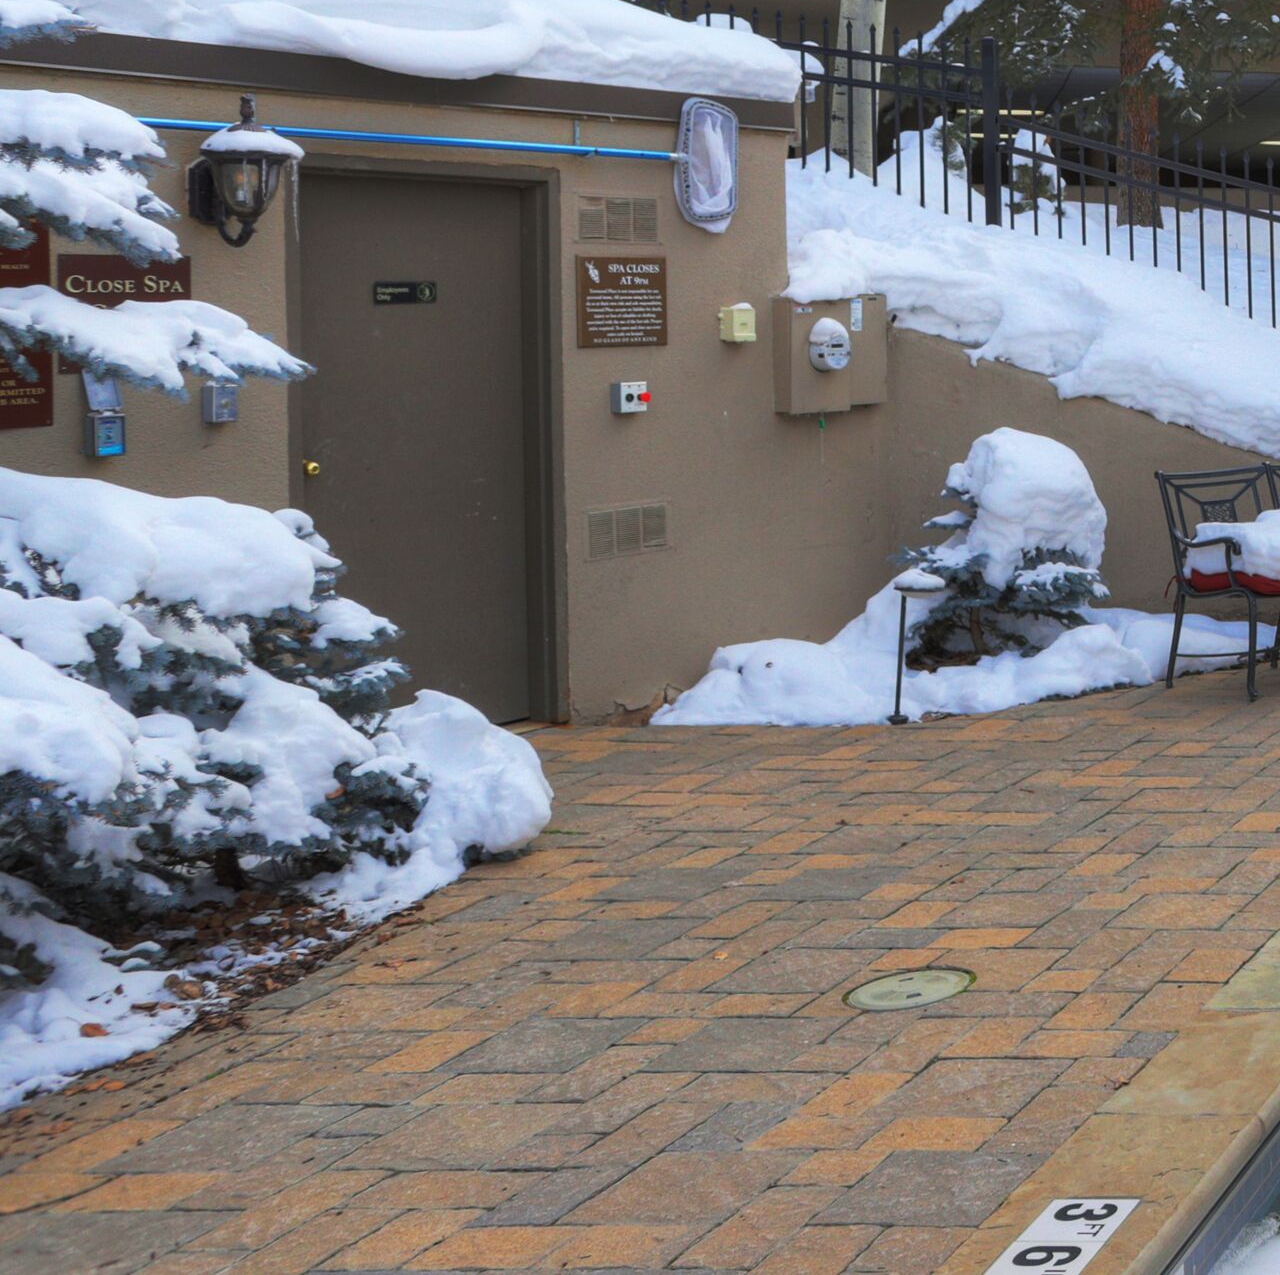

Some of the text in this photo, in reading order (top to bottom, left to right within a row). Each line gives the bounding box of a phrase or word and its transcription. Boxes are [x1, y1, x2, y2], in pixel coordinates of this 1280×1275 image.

[607, 263, 660, 274] SPA CLOSES
[65, 274, 184, 293] CLOSE SPA
[620, 276, 633, 285] AT
[1054, 1203, 1118, 1221] 3
[1077, 1223, 1105, 1237] FT
[1012, 1245, 1082, 1266] 6
